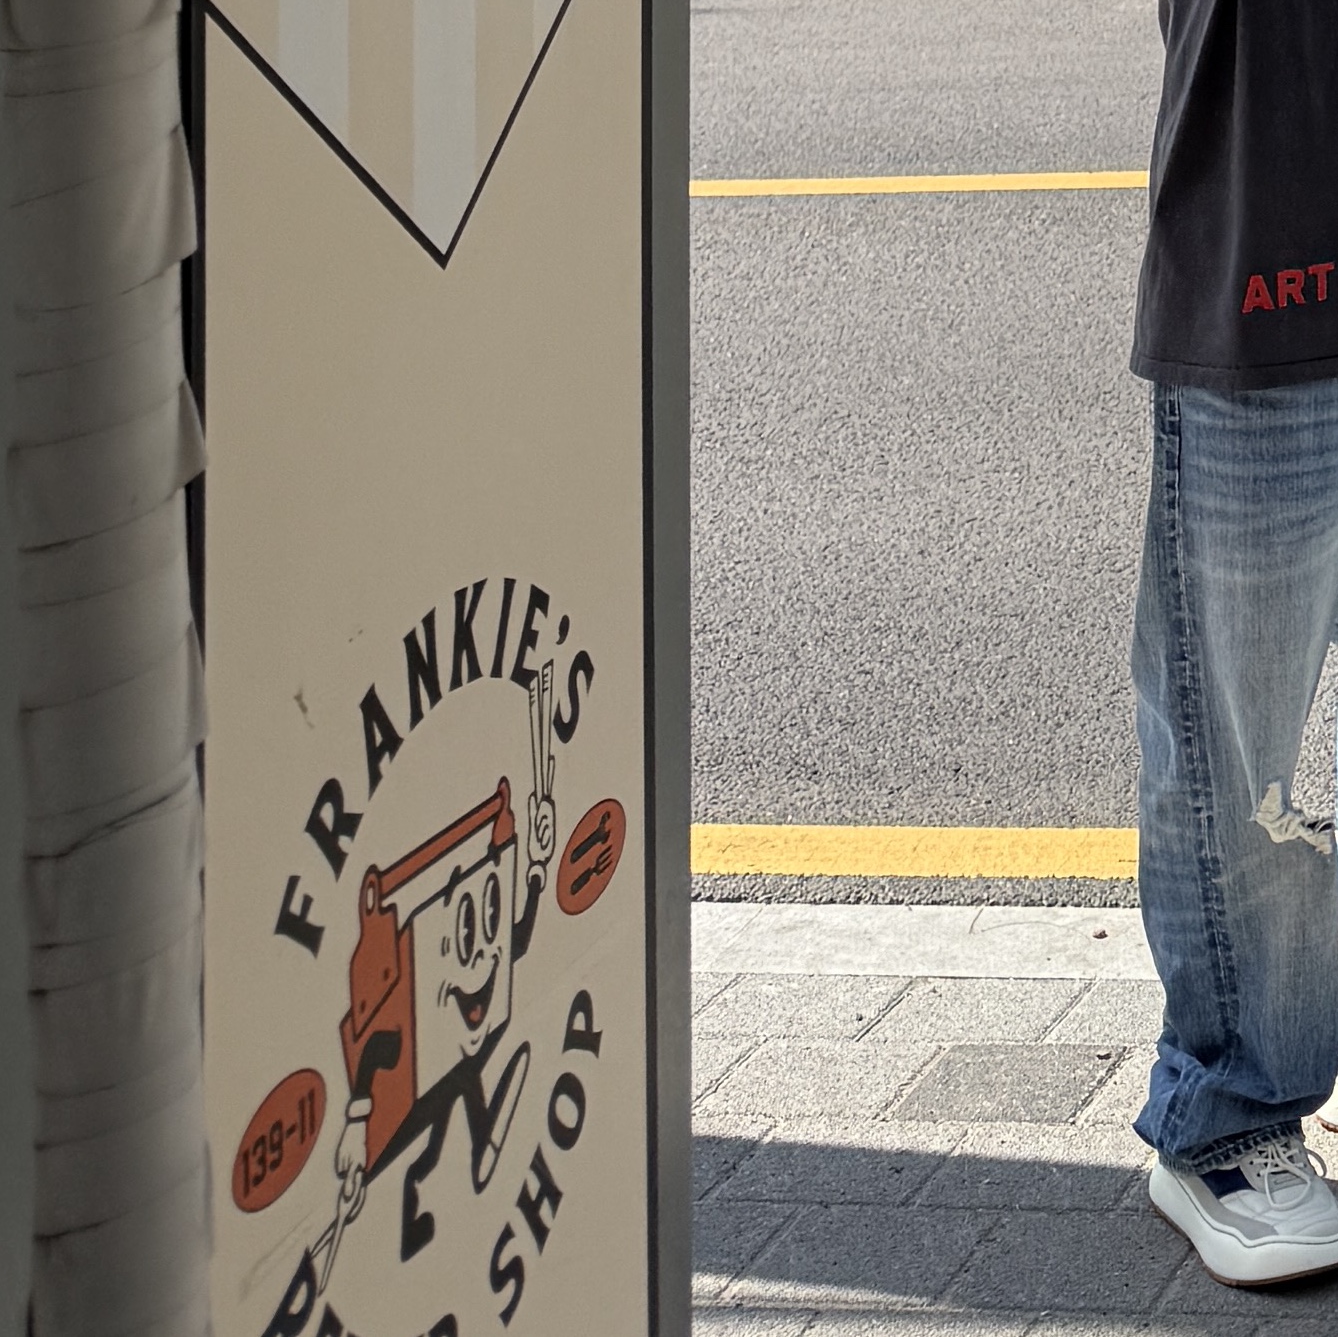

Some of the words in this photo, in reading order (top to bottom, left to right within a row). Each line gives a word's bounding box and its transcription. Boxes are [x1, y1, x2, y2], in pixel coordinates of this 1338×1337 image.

[1241, 263, 1335, 314] ART
[273, 576, 595, 959] FRANKIE'S
[241, 1087, 316, 1199] 139-11
[489, 987, 604, 1327] SHOP
